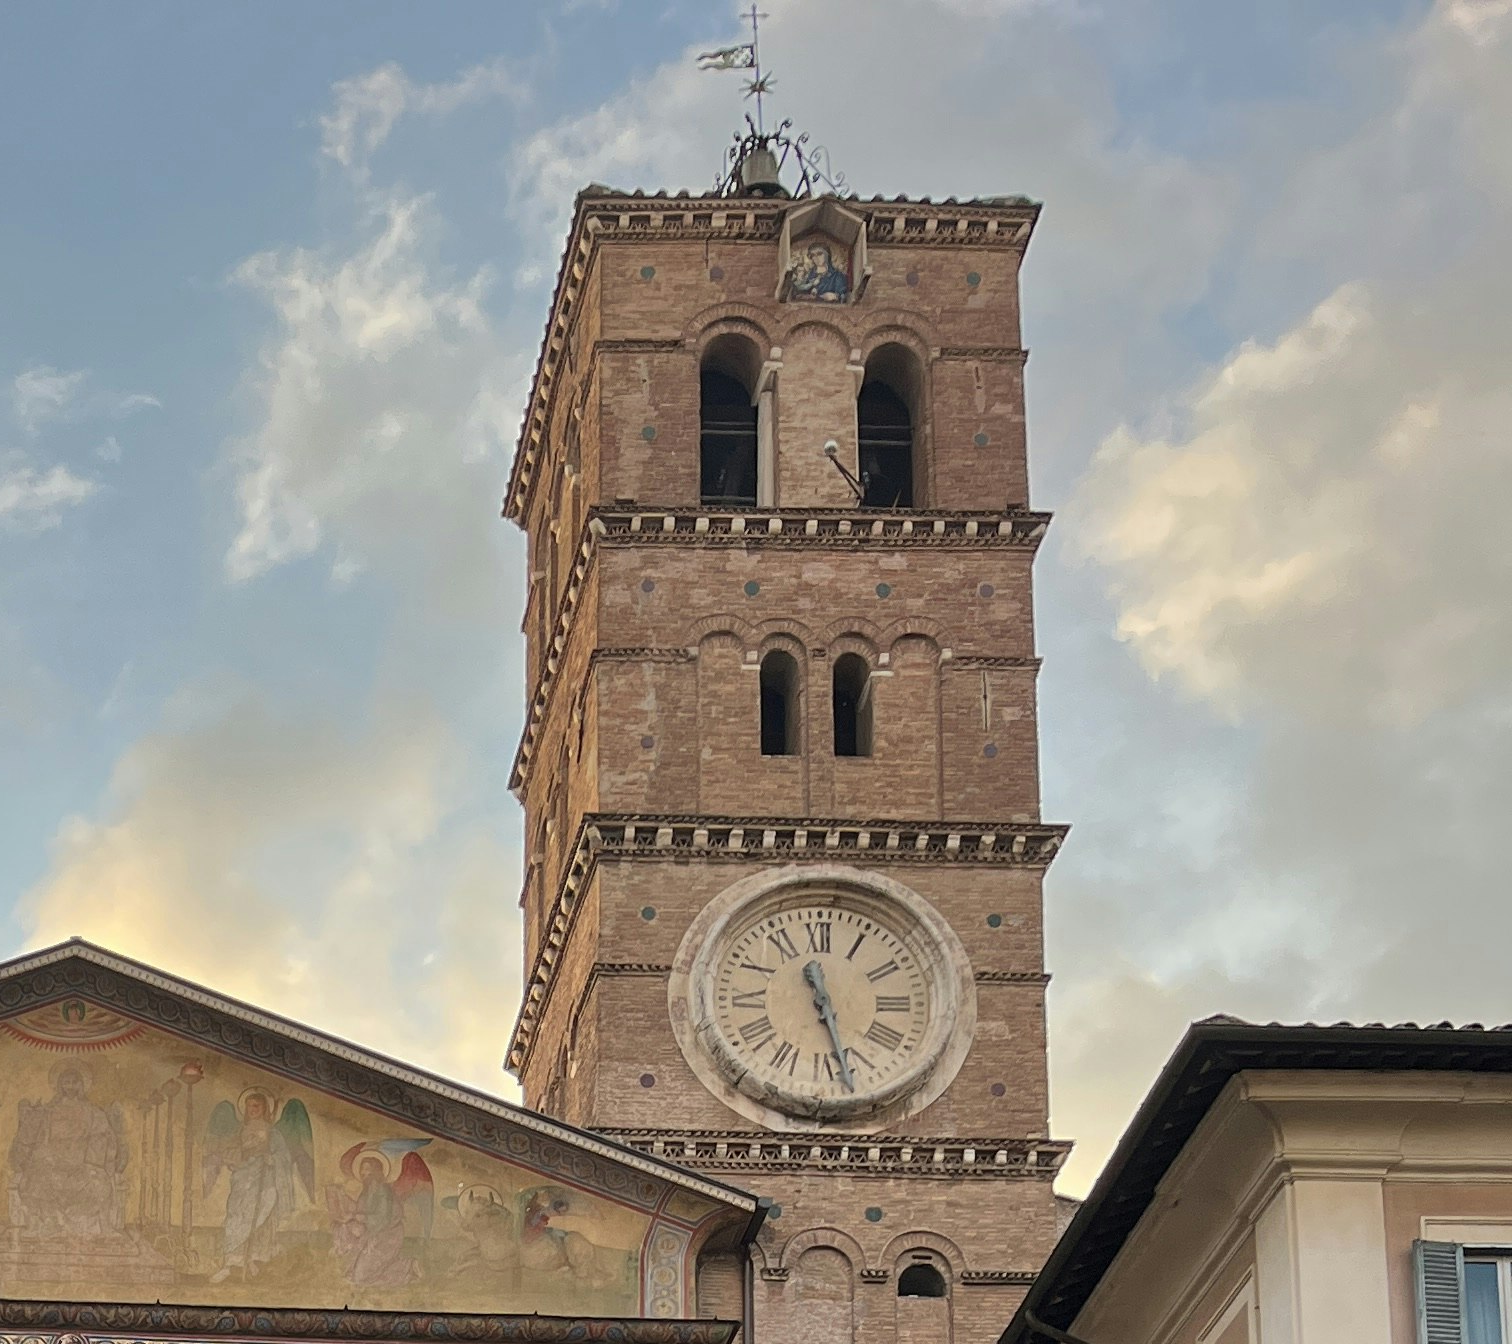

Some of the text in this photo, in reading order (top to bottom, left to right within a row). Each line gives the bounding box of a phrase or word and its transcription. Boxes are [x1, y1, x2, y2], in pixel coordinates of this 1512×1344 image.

[767, 928, 800, 964] XI
[804, 921, 832, 953] XII
[845, 932, 866, 961] I
[739, 956, 776, 980] X
[865, 959, 900, 983] II
[875, 994, 910, 1012] III
